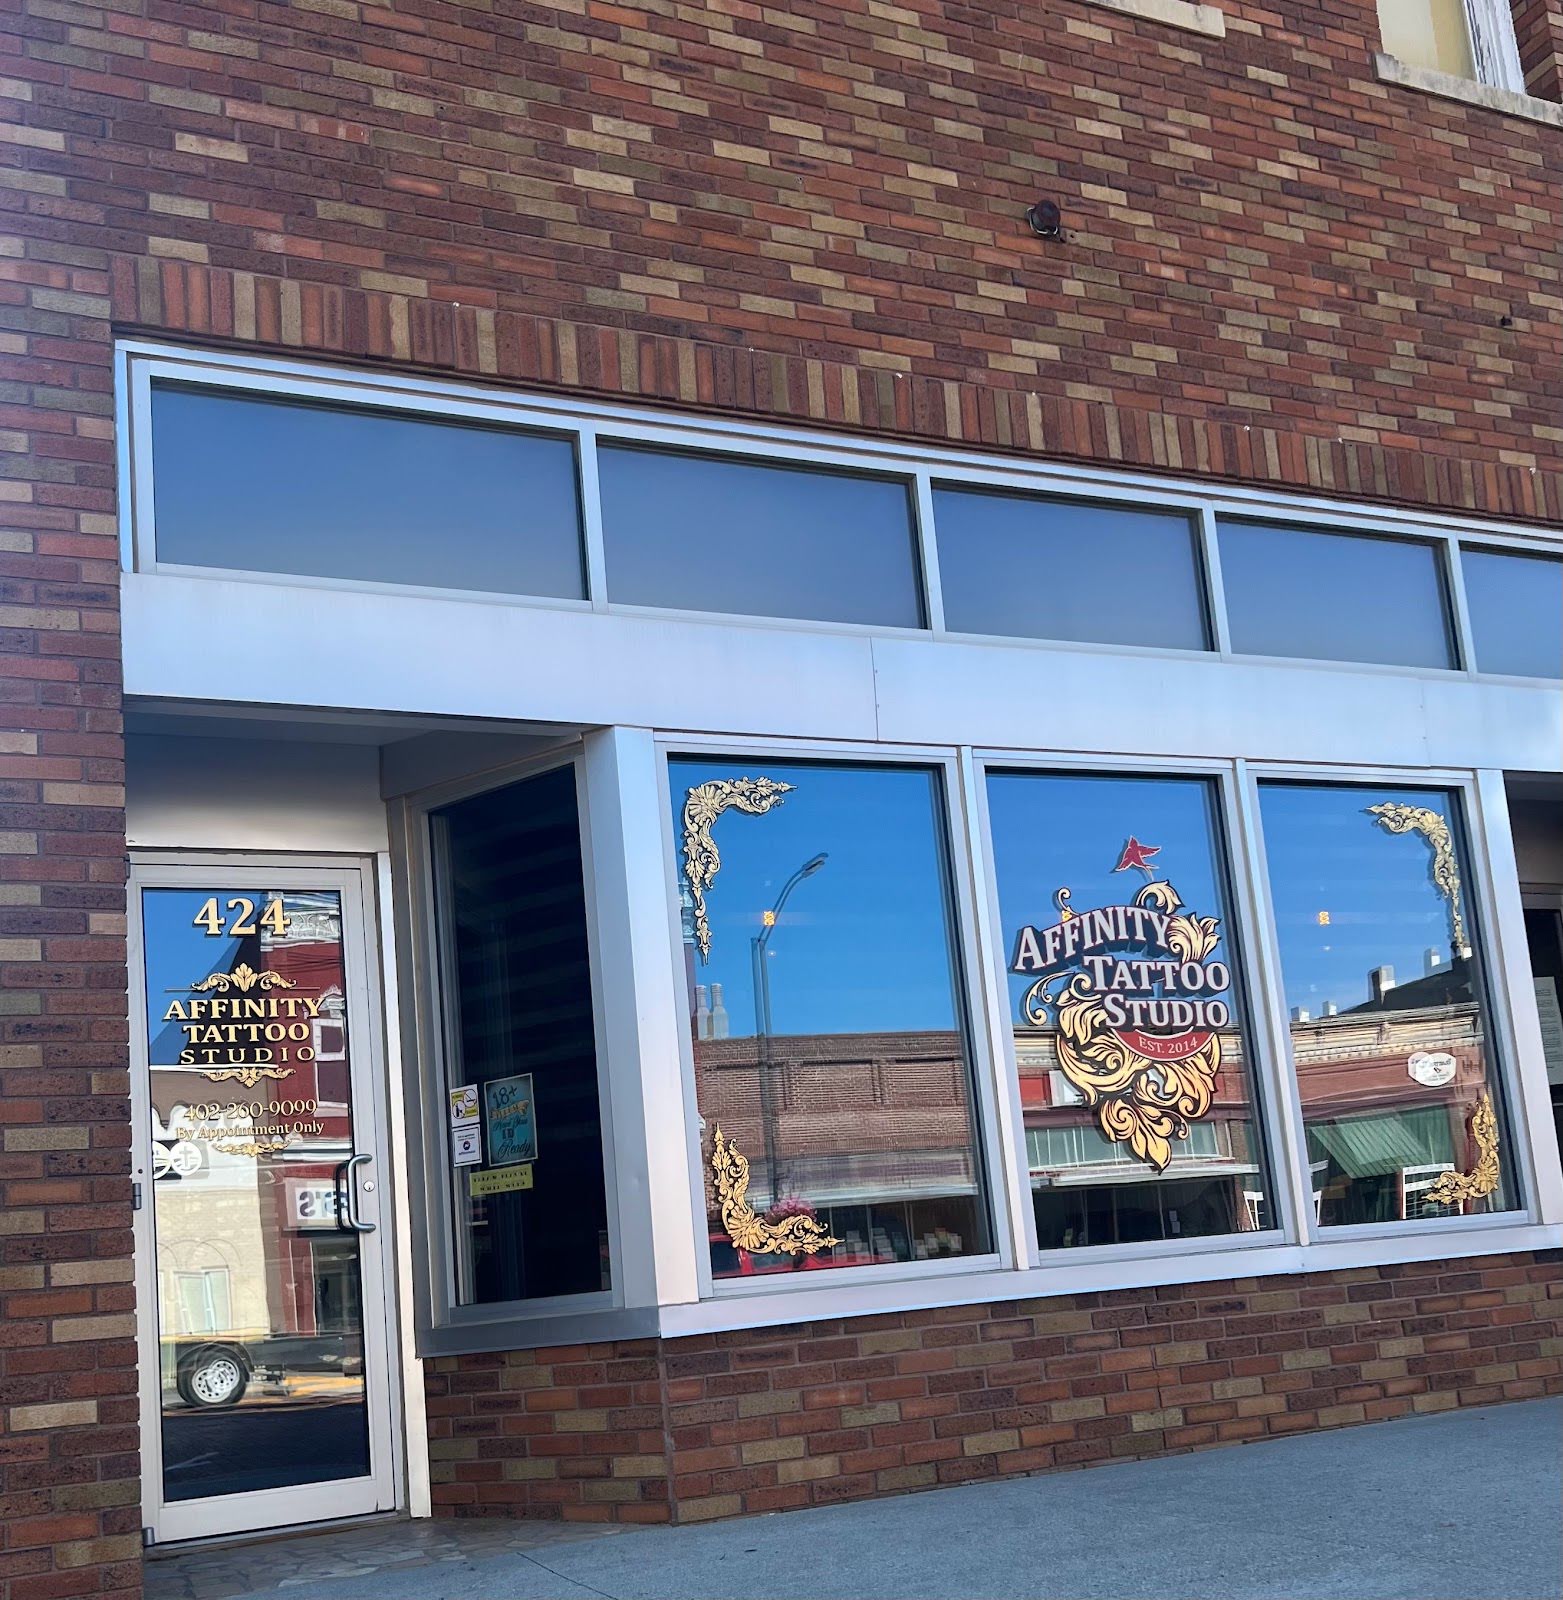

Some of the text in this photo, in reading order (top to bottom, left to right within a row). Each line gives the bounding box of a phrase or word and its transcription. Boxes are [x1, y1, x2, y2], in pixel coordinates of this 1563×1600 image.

[193, 897, 291, 936] 424
[1013, 906, 1172, 971] AFFINITY
[1082, 955, 1230, 991] TATTOO
[163, 997, 323, 1020] AFFINITY
[1104, 993, 1229, 1028] STUDIO
[183, 1022, 310, 1044] TATTOO
[180, 1046, 315, 1065] STUDIO
[1138, 1036, 1198, 1054] EST. 2014
[493, 1085, 518, 1108] 18+
[184, 1099, 317, 1121] 402-260-9099
[176, 1119, 325, 1140] By Appointment Only
